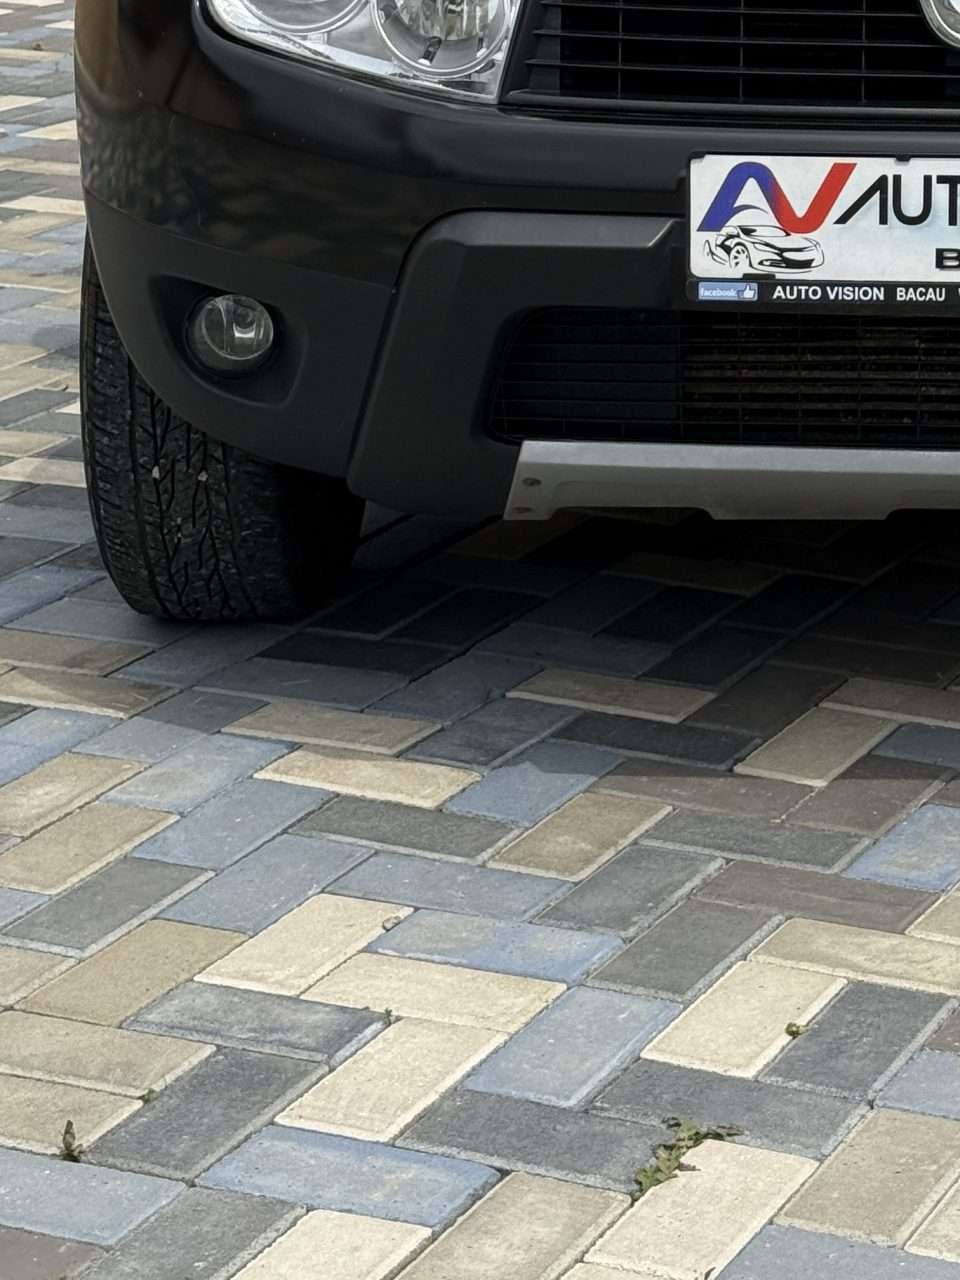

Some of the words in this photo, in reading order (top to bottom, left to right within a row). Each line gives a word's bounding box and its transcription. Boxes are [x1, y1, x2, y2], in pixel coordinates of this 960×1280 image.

[773, 286, 822, 301] AUTO
[826, 286, 885, 301] VISION
[896, 287, 946, 301] BACAU
